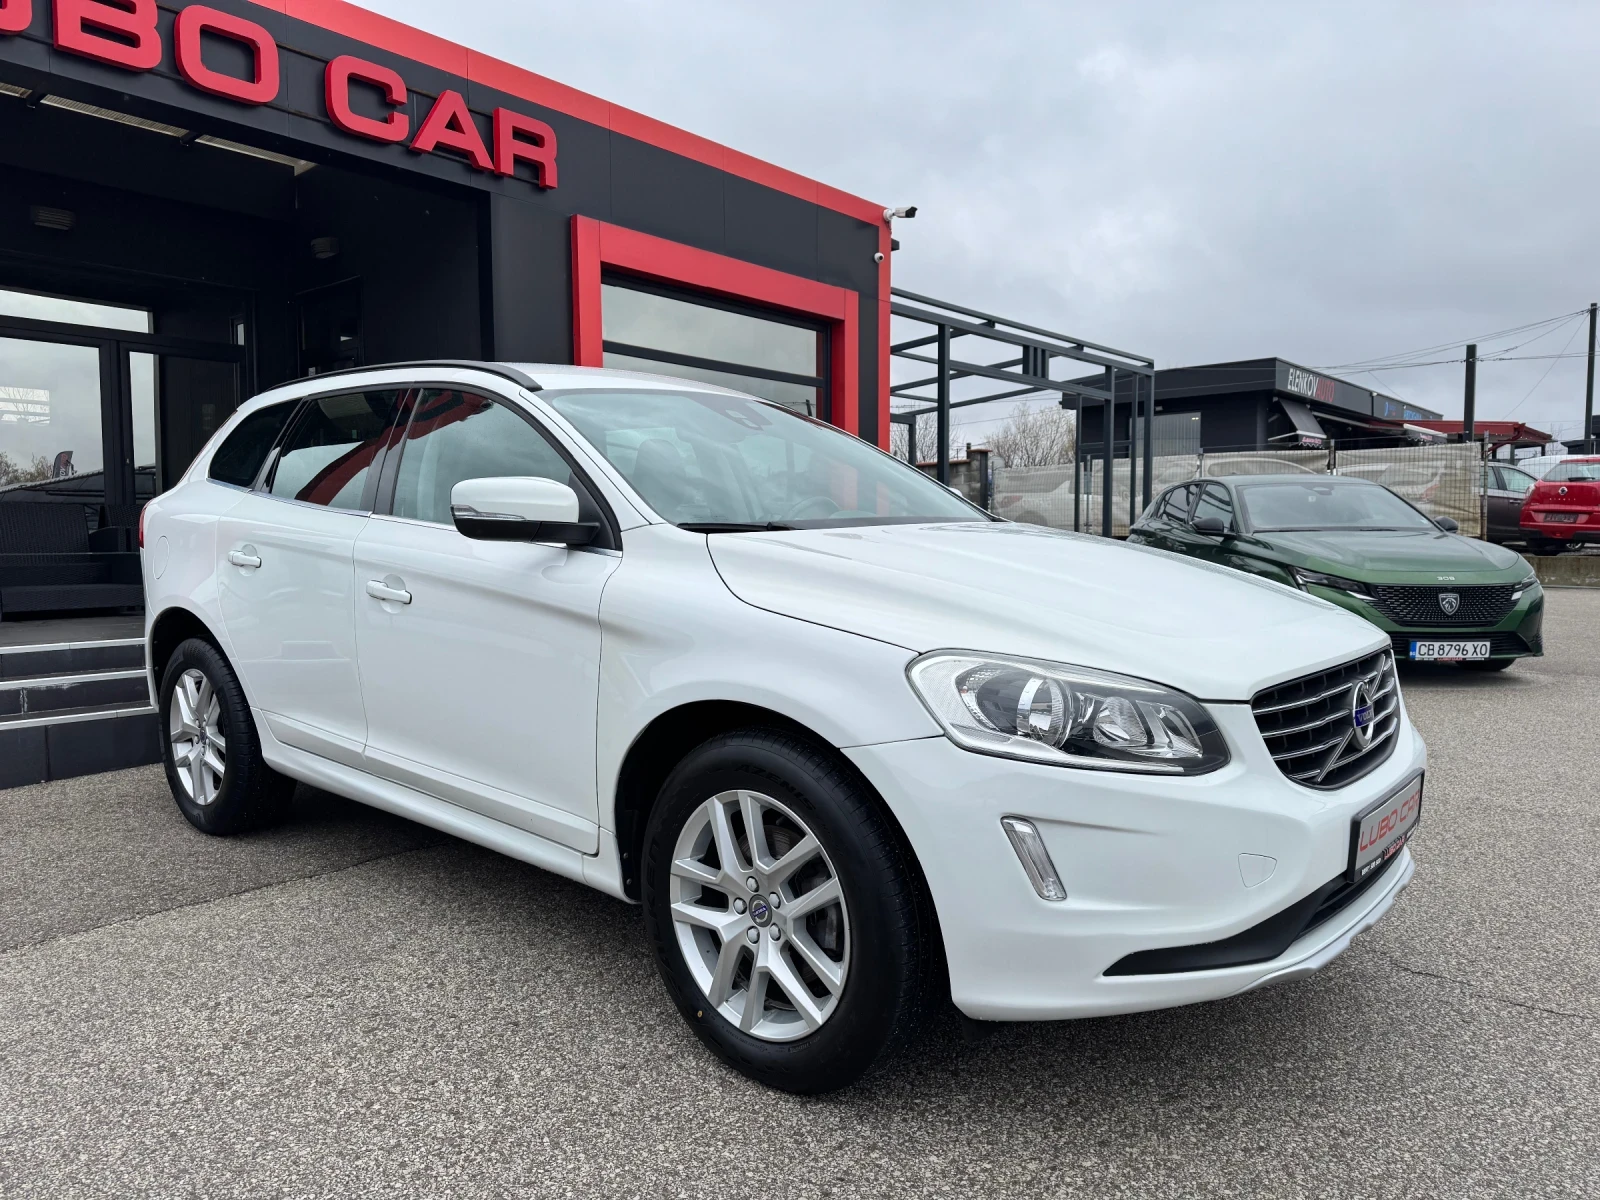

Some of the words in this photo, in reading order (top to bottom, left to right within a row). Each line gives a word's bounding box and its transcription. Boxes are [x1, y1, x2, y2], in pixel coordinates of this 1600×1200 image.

[0, 0, 280, 104] BO
[325, 55, 558, 189] CAR
[1418, 643, 1435, 657] CB
[1437, 643, 1469, 657] 8796
[1471, 643, 1488, 657] XO
[1360, 808, 1398, 852] LUBO
[1400, 788, 1420, 823] CAR
